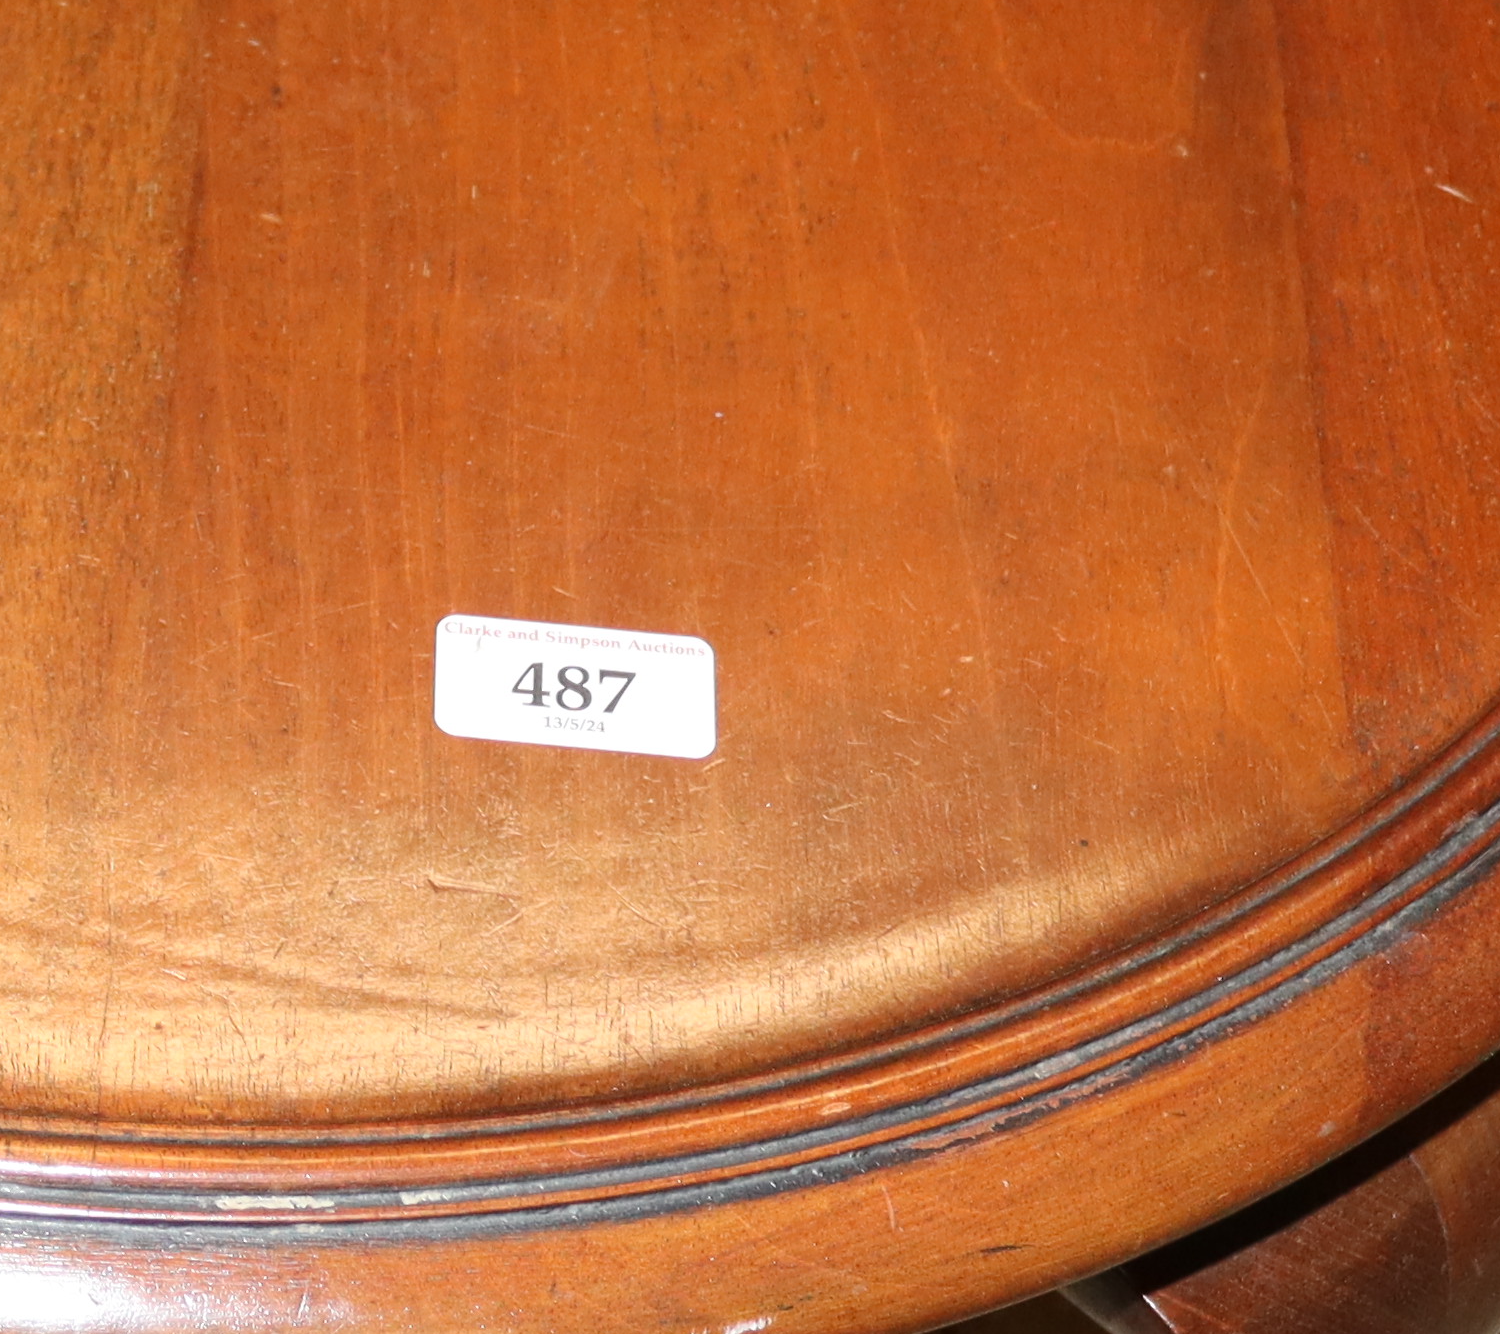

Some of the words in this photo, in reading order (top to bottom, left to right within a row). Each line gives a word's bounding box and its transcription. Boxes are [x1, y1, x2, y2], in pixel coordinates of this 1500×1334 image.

[444, 621, 502, 638] Clarke
[507, 629, 540, 642] and
[545, 630, 621, 649] Simpson
[628, 639, 705, 656] Auctions
[511, 662, 637, 714] 487
[543, 715, 606, 733] 13/5/24
